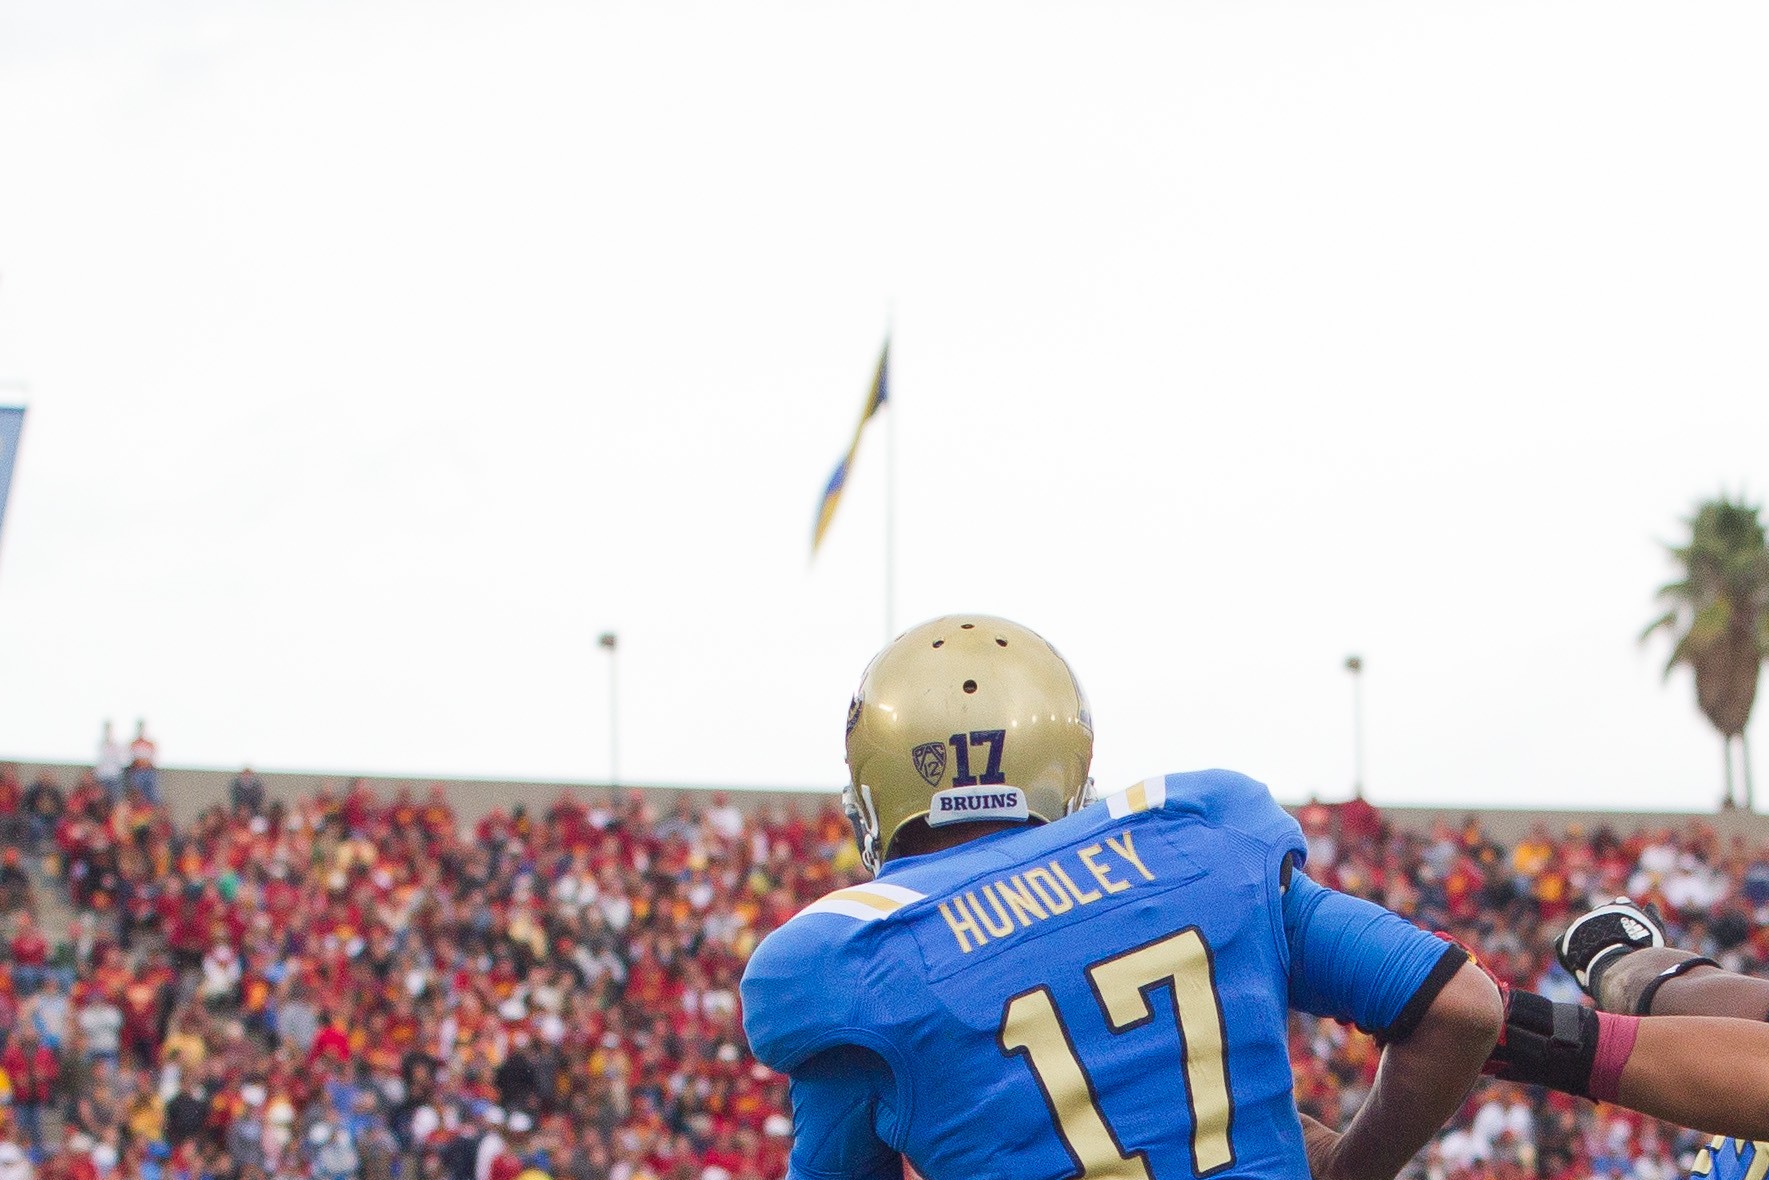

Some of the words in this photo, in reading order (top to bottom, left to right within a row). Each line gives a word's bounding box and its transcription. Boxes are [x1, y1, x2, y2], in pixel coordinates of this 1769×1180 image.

[911, 743, 946, 770] PAC
[923, 761, 941, 778] 12
[949, 730, 1006, 786] 17
[940, 793, 1018, 812] BRUINS
[938, 830, 1156, 954] HUNDLEY
